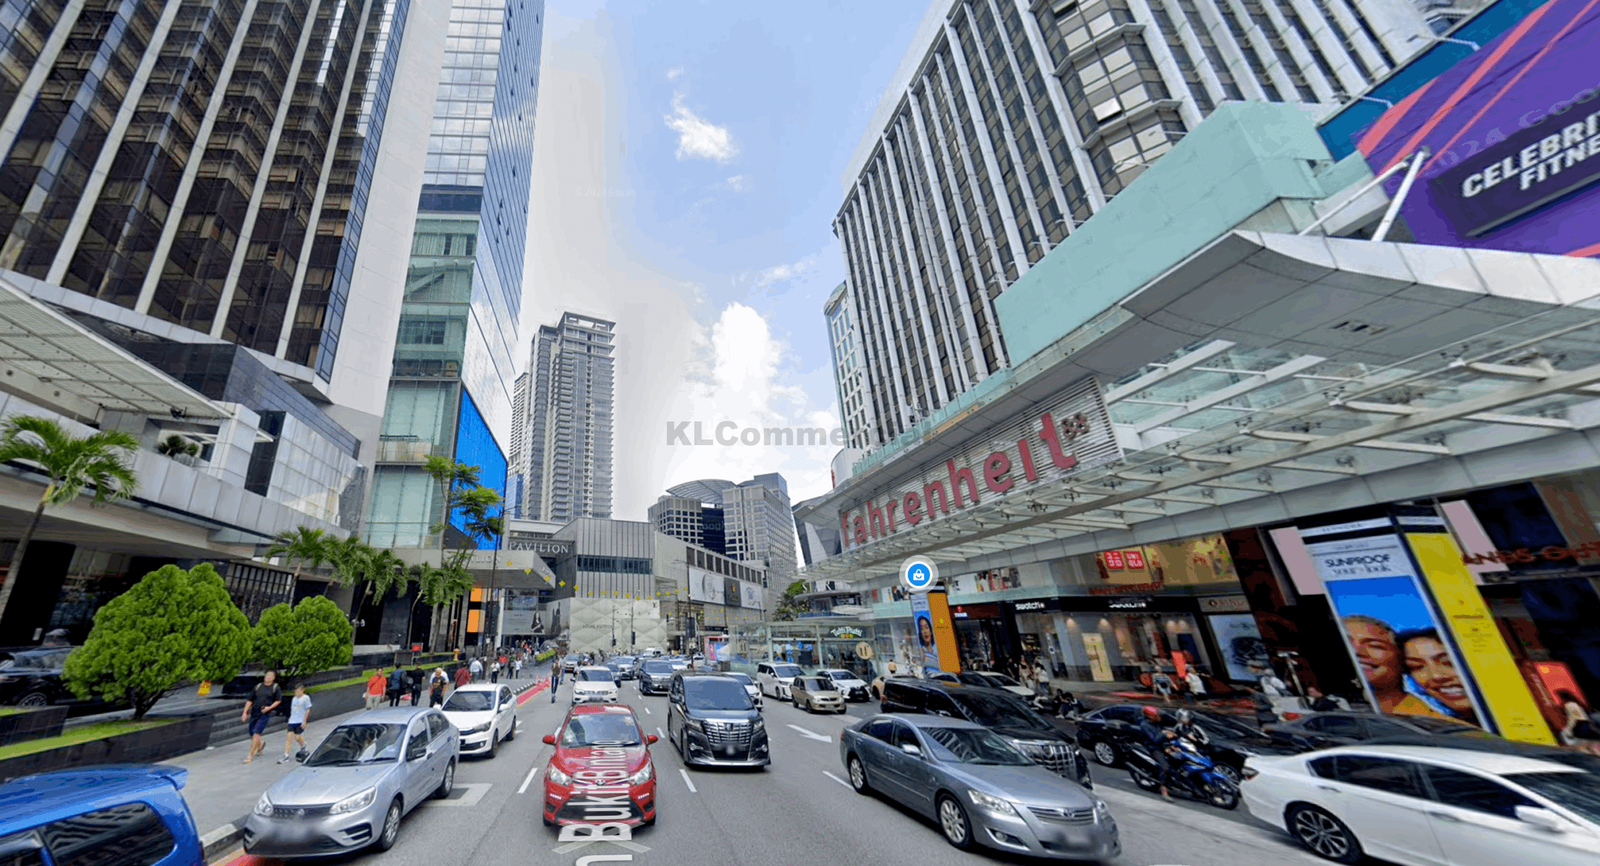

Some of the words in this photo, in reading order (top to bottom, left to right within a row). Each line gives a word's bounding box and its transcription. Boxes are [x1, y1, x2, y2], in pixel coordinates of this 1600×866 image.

[841, 412, 1077, 548] fahrenheit
[510, 541, 569, 554] PAVILION
[1324, 553, 1391, 568] SUNPROOF
